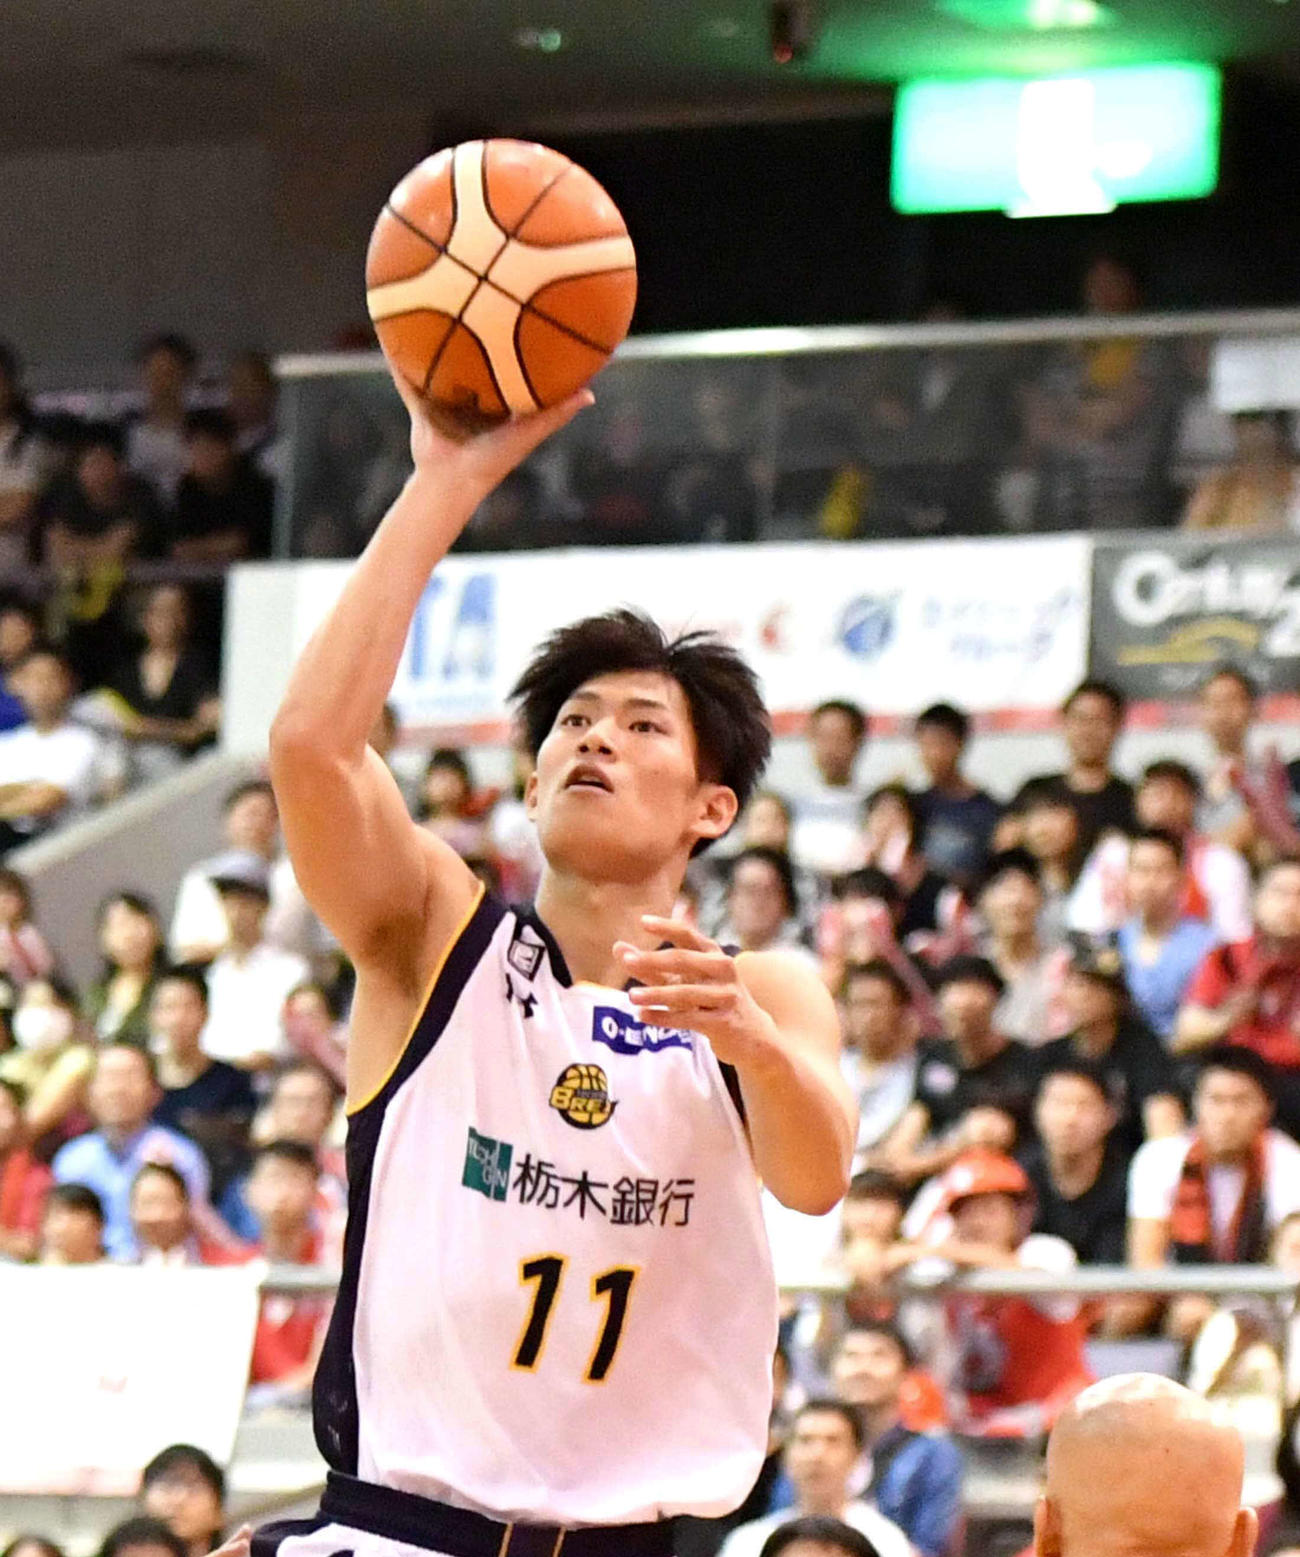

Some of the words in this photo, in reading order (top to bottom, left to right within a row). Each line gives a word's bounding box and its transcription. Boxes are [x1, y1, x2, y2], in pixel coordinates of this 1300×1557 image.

[512, 1152, 695, 1227] 栃木銀行
[510, 1252, 641, 1385] 11
